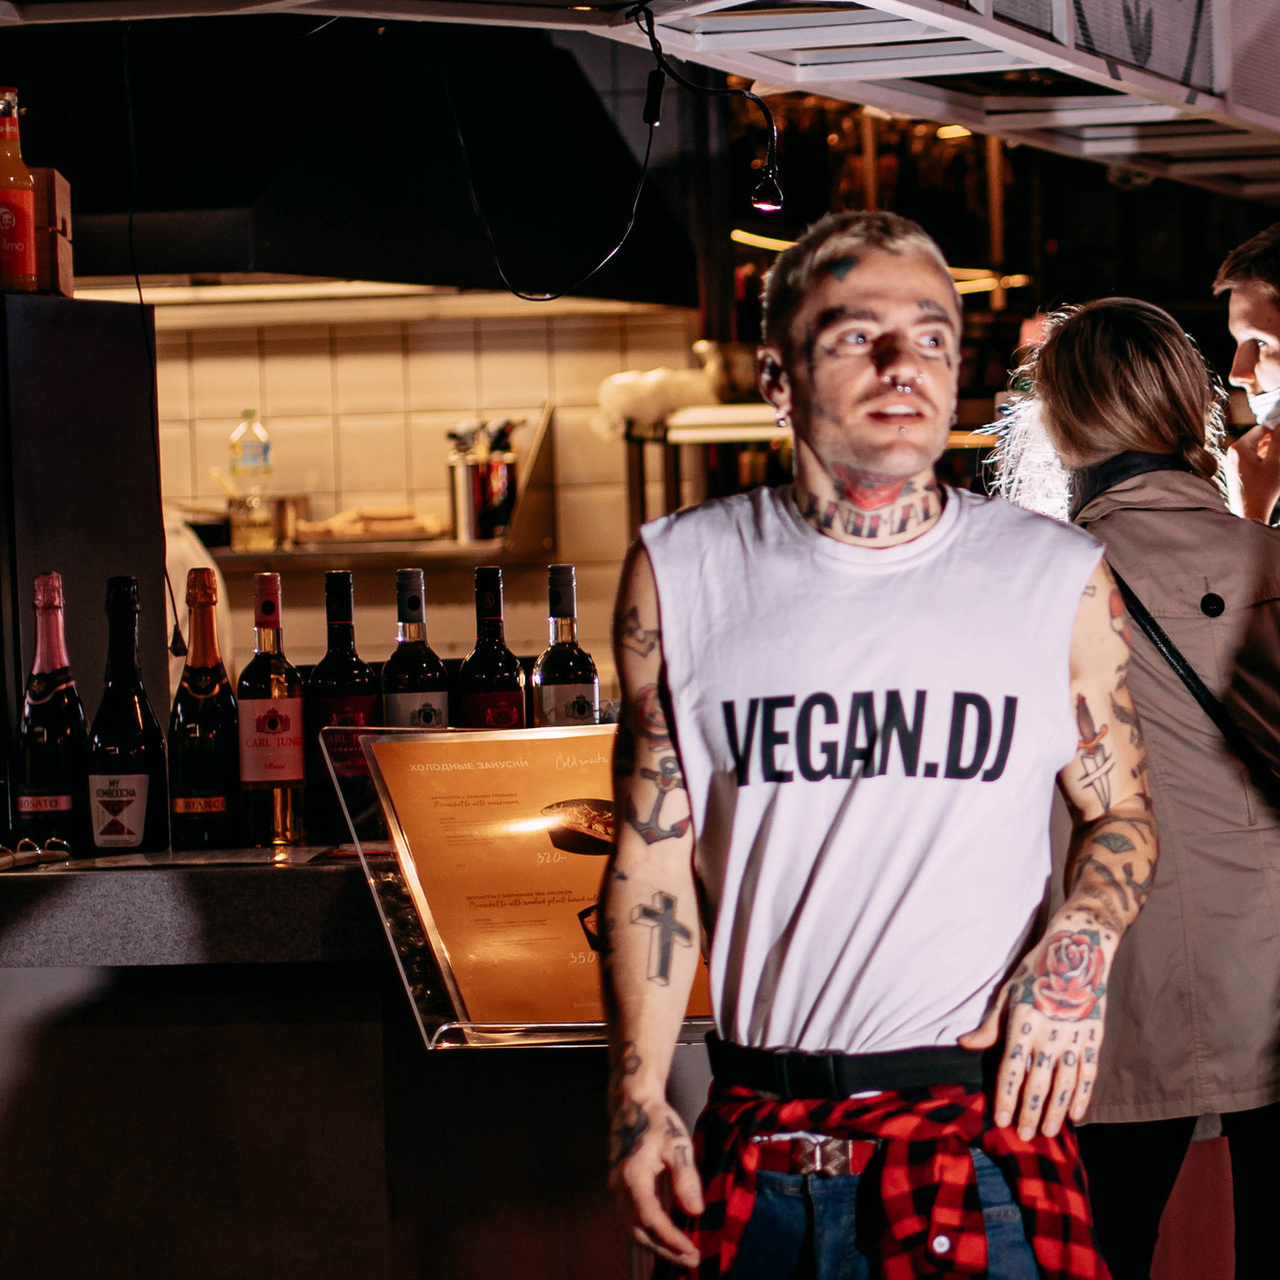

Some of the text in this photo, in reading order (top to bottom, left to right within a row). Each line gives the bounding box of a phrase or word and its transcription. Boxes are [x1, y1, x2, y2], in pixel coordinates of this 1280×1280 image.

[721, 688, 1018, 786] VEGAN.DJ
[246, 738, 272, 748] CARL
[410, 762, 475, 772] ХОЛОДНЫЕ
[555, 754, 577, 770] Cold
[109, 779, 119, 788] MY
